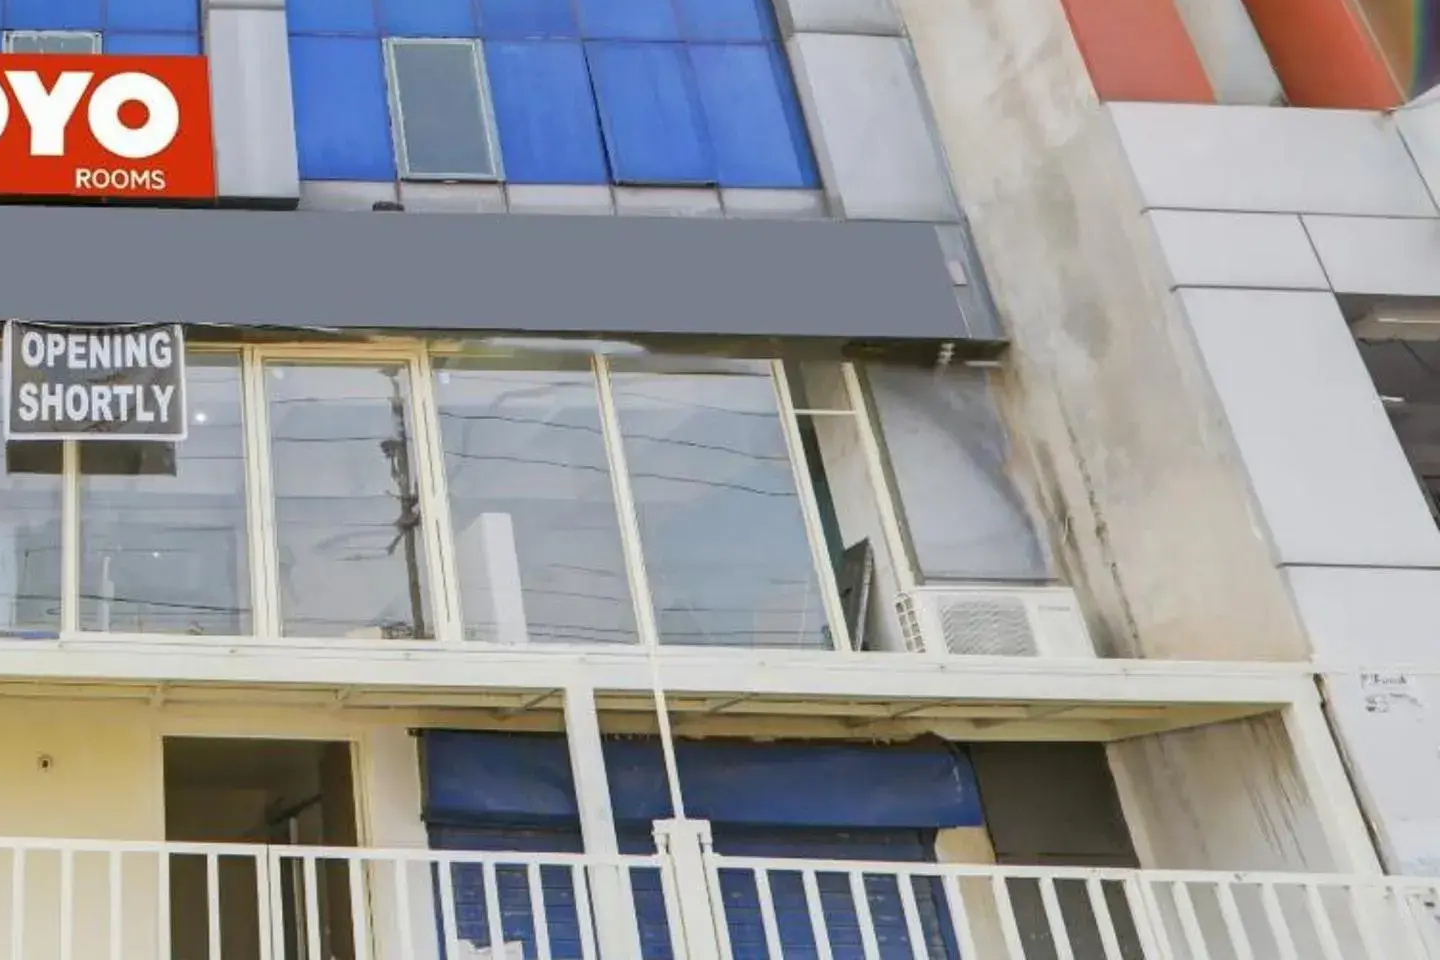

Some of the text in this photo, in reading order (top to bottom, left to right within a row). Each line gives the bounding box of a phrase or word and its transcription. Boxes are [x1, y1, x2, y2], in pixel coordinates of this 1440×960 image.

[74, 167, 166, 190] ROOMS
[20, 330, 173, 369] OPENING
[17, 382, 175, 423] SHORTLY
